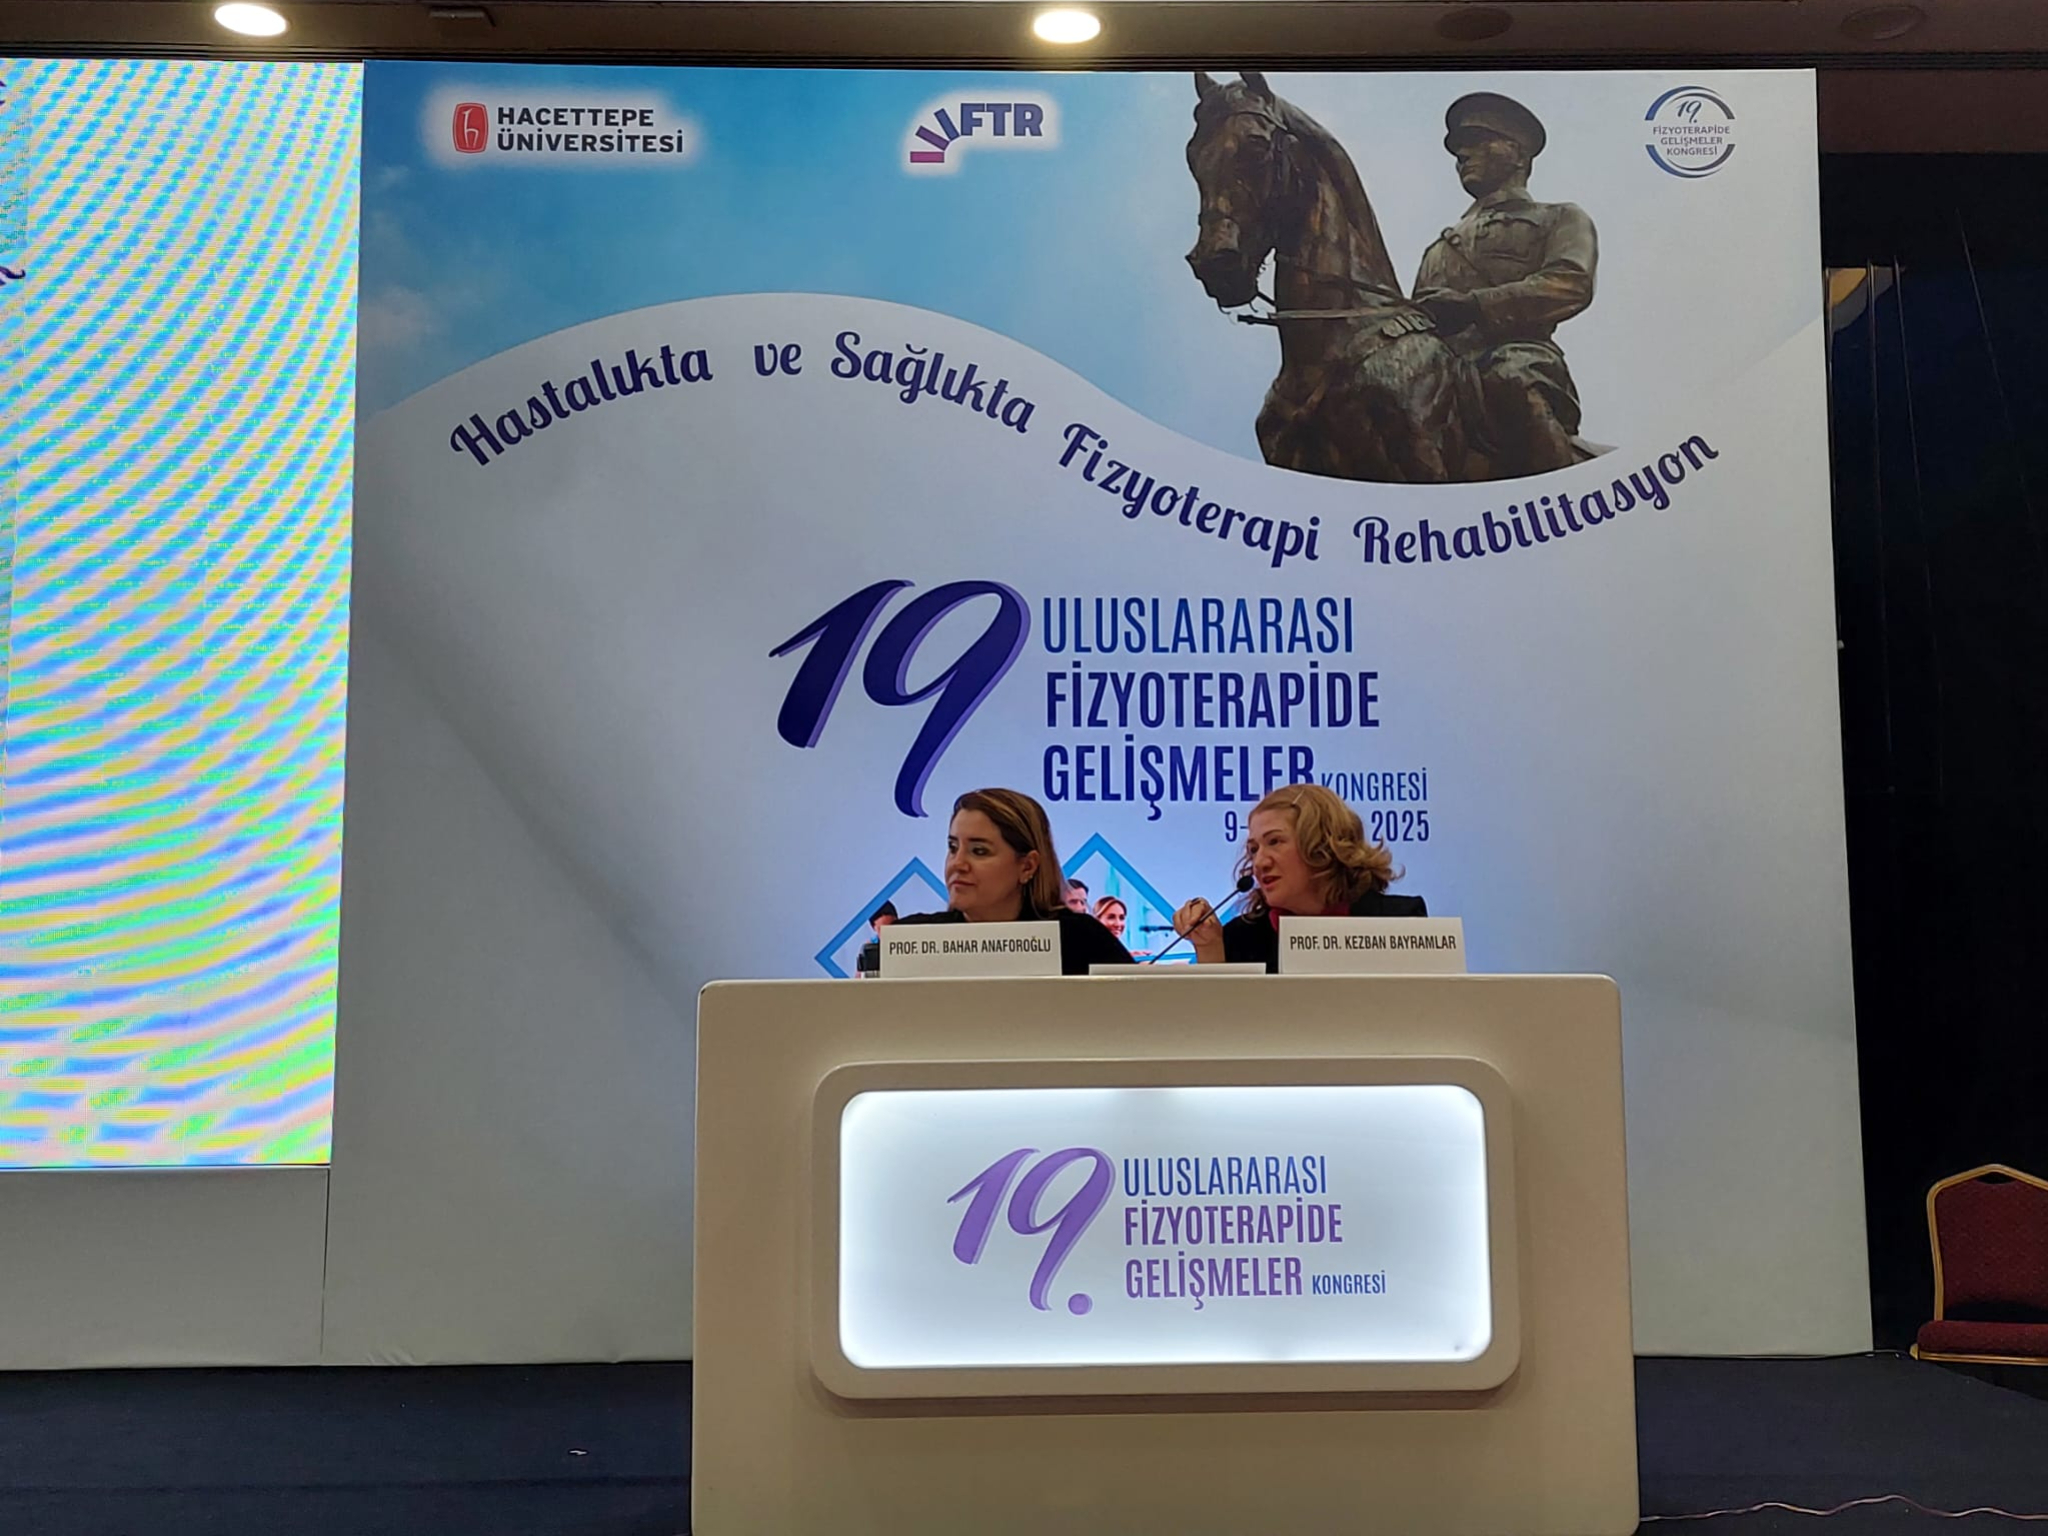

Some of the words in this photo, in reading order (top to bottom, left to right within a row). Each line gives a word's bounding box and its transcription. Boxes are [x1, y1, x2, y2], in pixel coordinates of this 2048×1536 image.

[497, 107, 654, 127] HACETTEPE
[961, 103, 1042, 136] FTR
[1653, 125, 1730, 135] FİZYOTERAPİDE
[497, 128, 684, 153] ÜNİVERSİTESİ
[1660, 136, 1723, 147] GELİŞMELER
[1666, 146, 1718, 156] KONGRESİ
[450, 344, 713, 465] Hastalıkta
[753, 342, 802, 375] ve
[830, 331, 1035, 434] Sağlıkta
[1058, 422, 1320, 568] Fizyoterapi
[1352, 433, 1719, 565] Rehabilitasyon
[1043, 597, 1353, 653] ULUSLARARASI
[1046, 661, 1379, 727] FİZYOTERAPİDE
[1371, 811, 1430, 842] 2025
[889, 941, 919, 955] PROF.
[921, 940, 940, 954] DR.
[943, 939, 978, 953] BAHAR
[981, 935, 1051, 953] ANAFOROĞLU
[1290, 936, 1320, 950] PROF.
[1323, 936, 1342, 949] DR.
[1345, 936, 1386, 950] KEZBAN
[1390, 935, 1457, 950] BAYRAMLAR
[1123, 1155, 1327, 1196] ULUSLARARASI
[947, 1147, 1116, 1316] 19.
[1124, 1197, 1343, 1246] FİZYOTERAPİDE
[1125, 1250, 1303, 1311] GELİŞMELER
[1312, 1269, 1386, 1295] KONGRESİ
